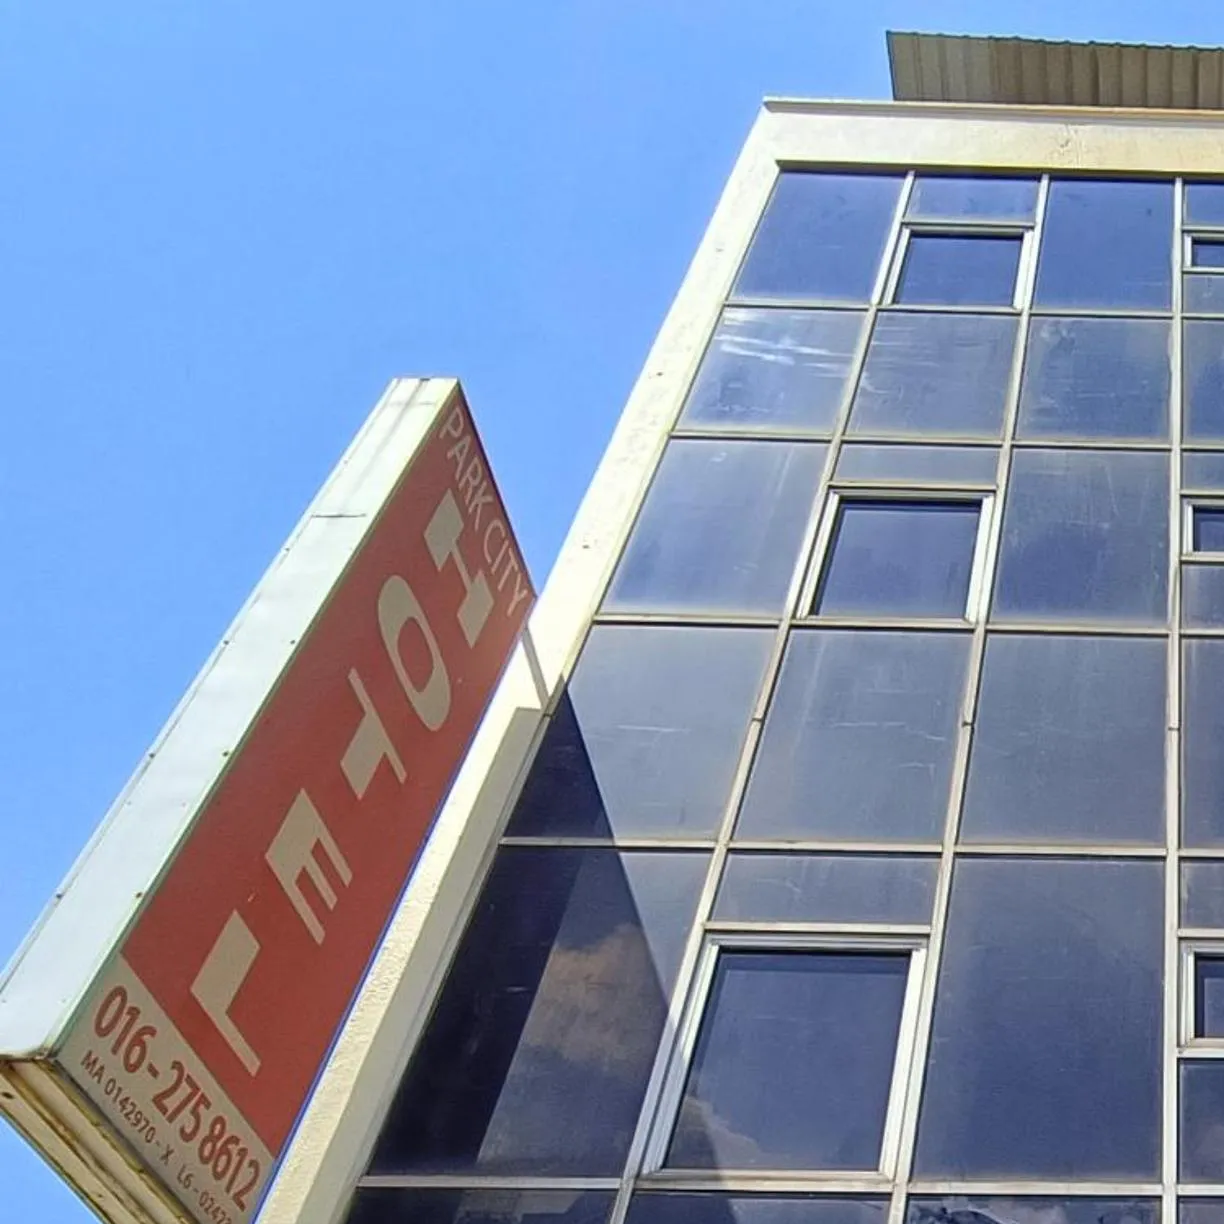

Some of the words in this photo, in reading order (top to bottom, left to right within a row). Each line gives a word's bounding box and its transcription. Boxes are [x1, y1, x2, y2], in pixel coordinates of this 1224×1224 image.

[439, 405, 495, 532] PARK
[483, 519, 528, 618] CITY
[190, 488, 494, 1077] HOTEL
[80, 1050, 106, 1084] MA
